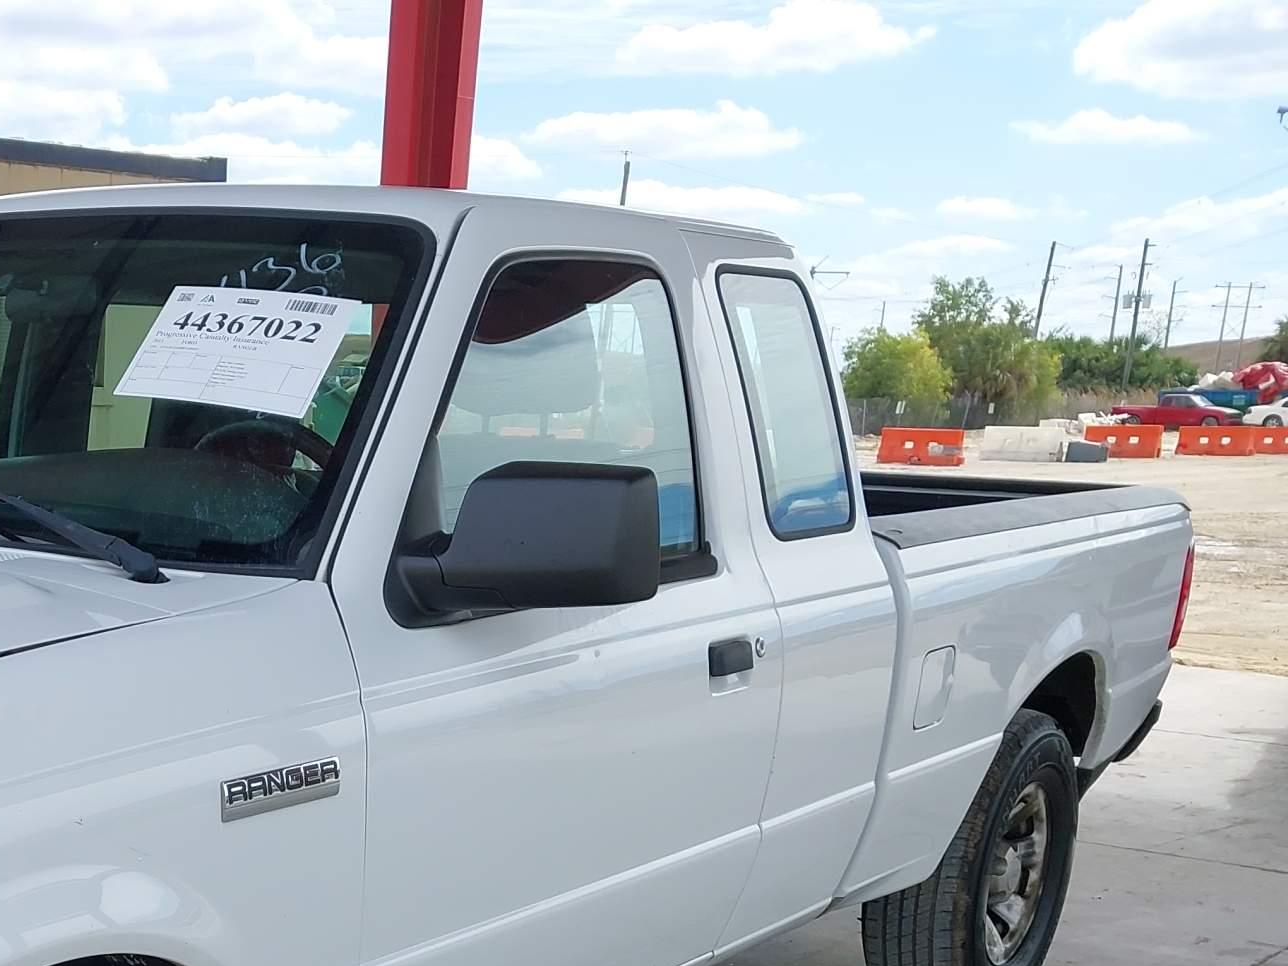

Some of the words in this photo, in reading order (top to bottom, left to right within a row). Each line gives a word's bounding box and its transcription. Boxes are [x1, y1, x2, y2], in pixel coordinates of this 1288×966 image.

[155, 330, 198, 341] Progressive
[199, 333, 230, 344] Casualty
[232, 336, 271, 346] Insurance
[173, 311, 322, 343] 44367022
[225, 759, 339, 806] RANGER
